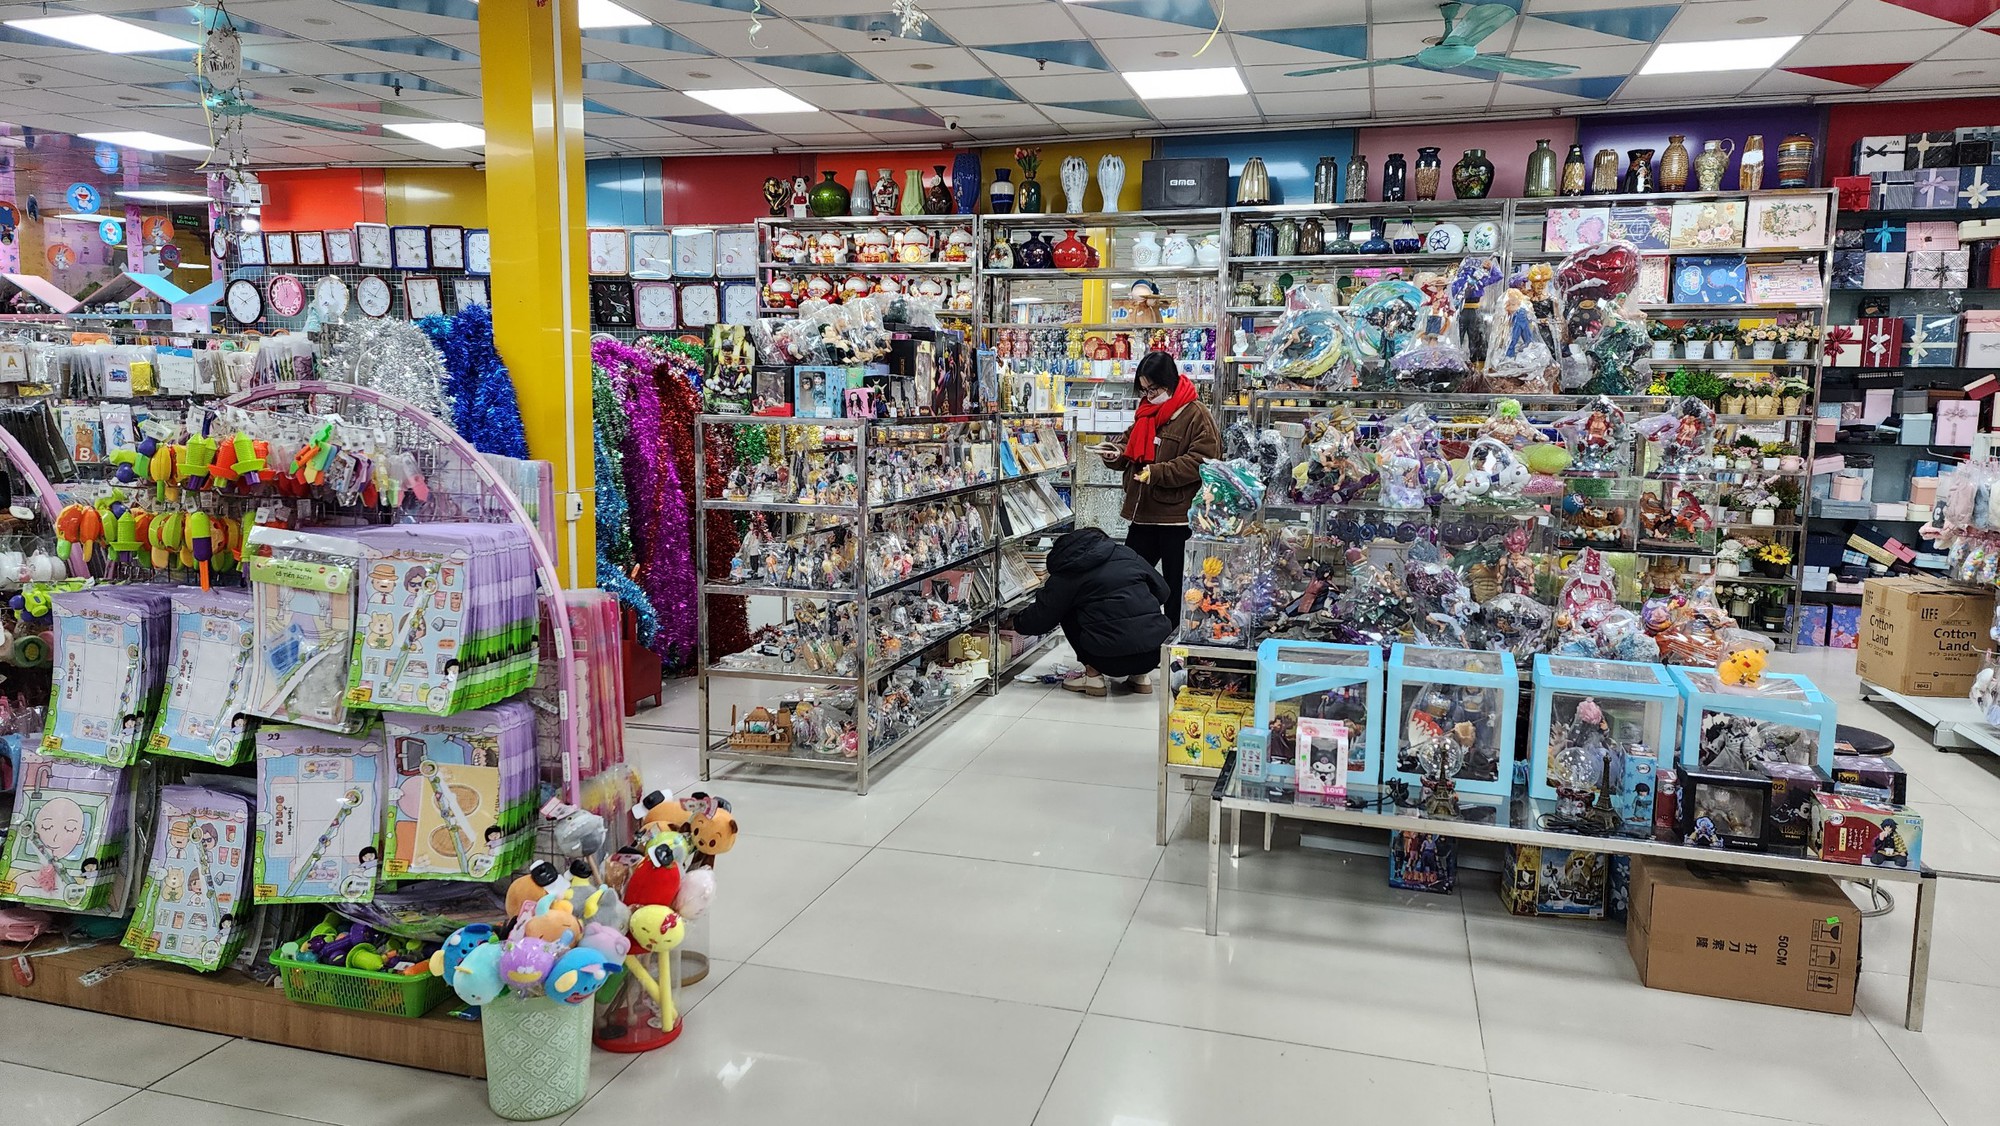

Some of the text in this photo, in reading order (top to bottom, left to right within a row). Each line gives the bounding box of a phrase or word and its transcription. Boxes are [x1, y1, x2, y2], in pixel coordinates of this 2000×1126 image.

[80, 448, 90, 462] B
[1921, 608, 1938, 619] LIFE
[1870, 614, 1894, 633] Cotton
[1872, 630, 1889, 646] Land
[1934, 628, 1976, 639] Cotton
[1939, 641, 1970, 651] Land
[1776, 935, 1789, 966] 50CM
